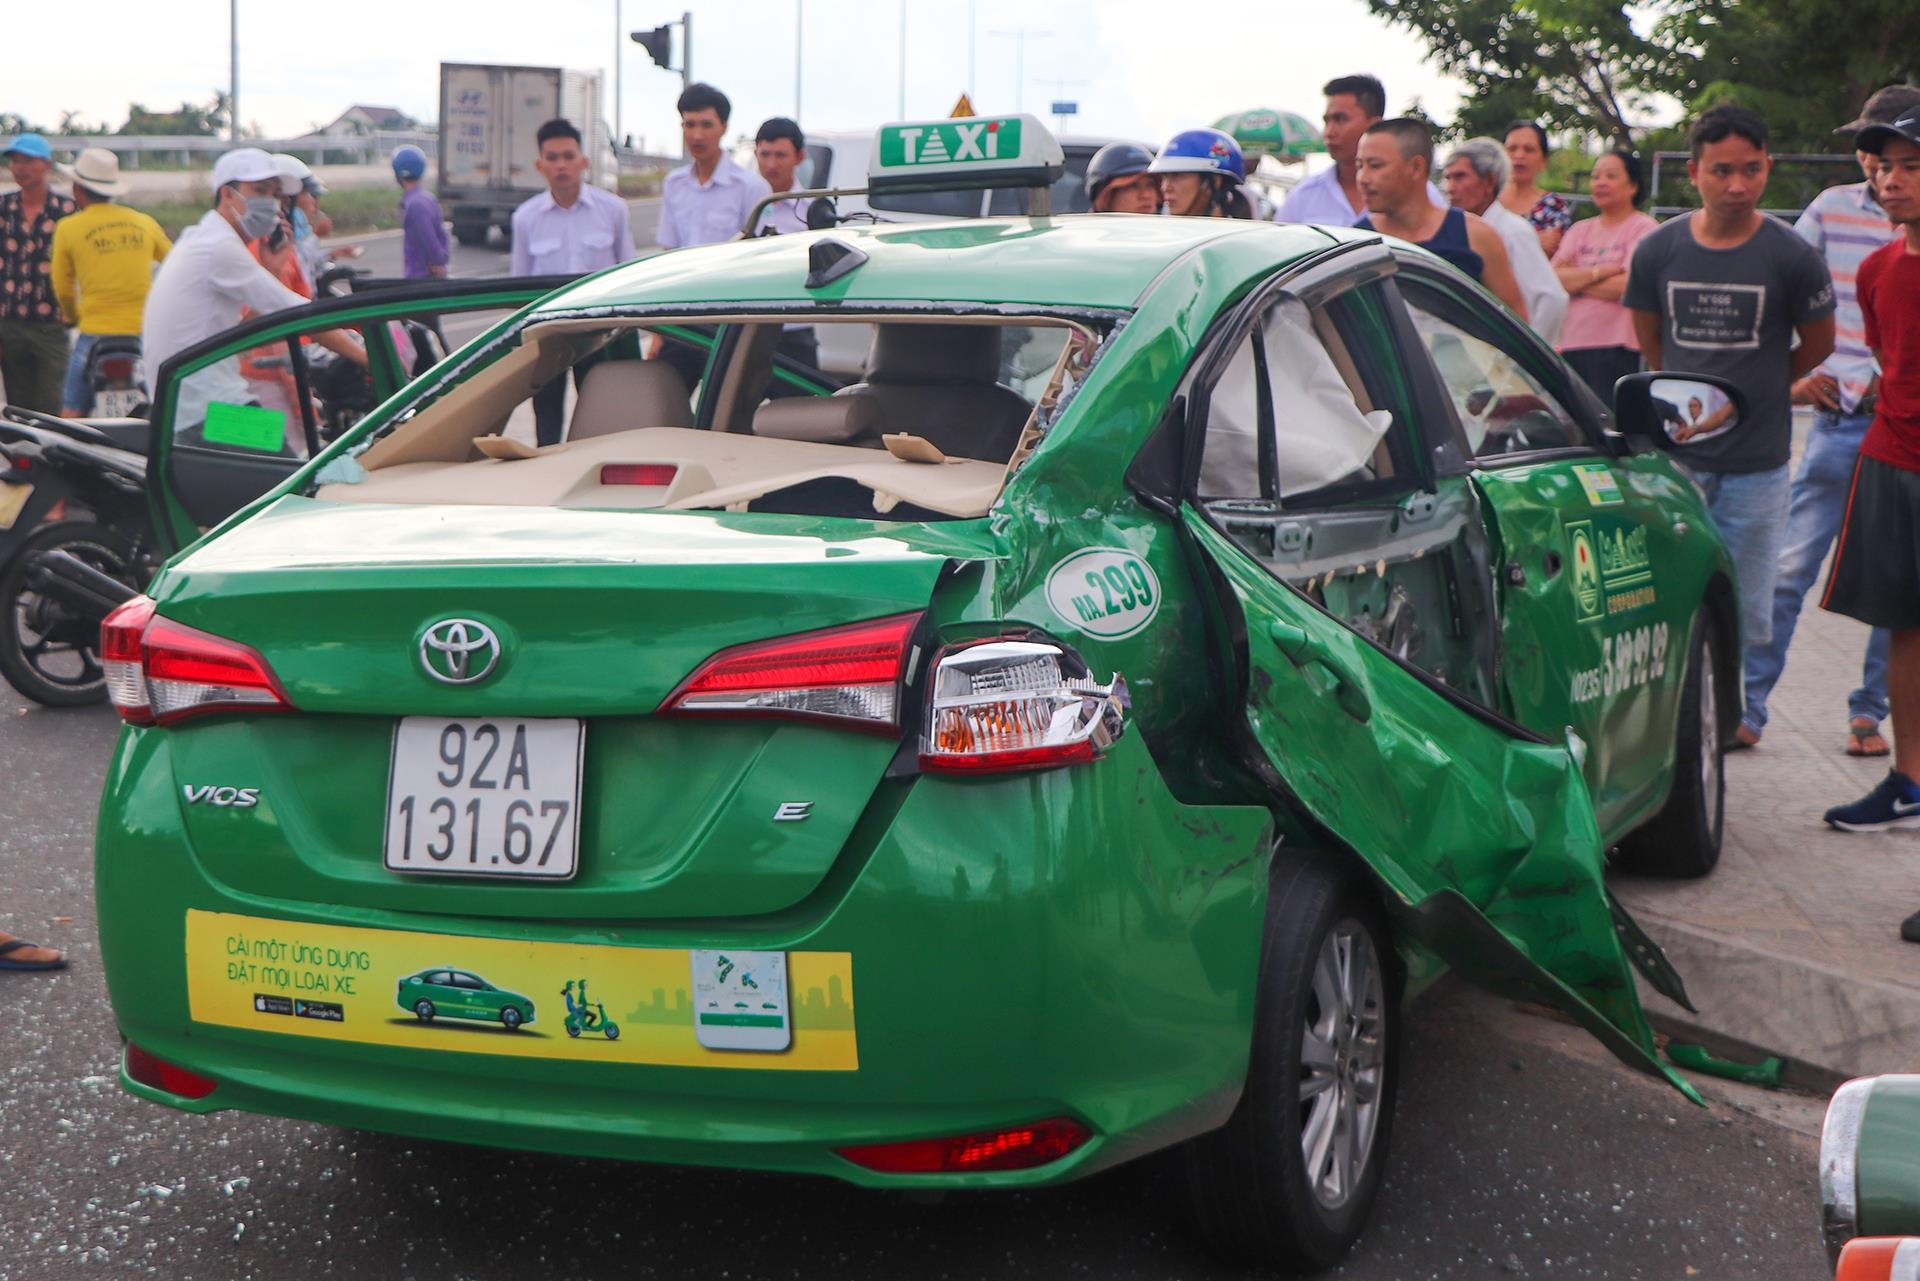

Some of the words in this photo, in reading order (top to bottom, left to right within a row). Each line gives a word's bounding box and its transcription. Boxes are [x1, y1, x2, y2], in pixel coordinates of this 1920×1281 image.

[437, 723, 530, 790] 92A
[184, 784, 259, 806] VIOS
[773, 801, 813, 820] E
[399, 796, 570, 866] 131.67
[334, 976, 356, 995] XE
[308, 1007, 329, 1018] Google
